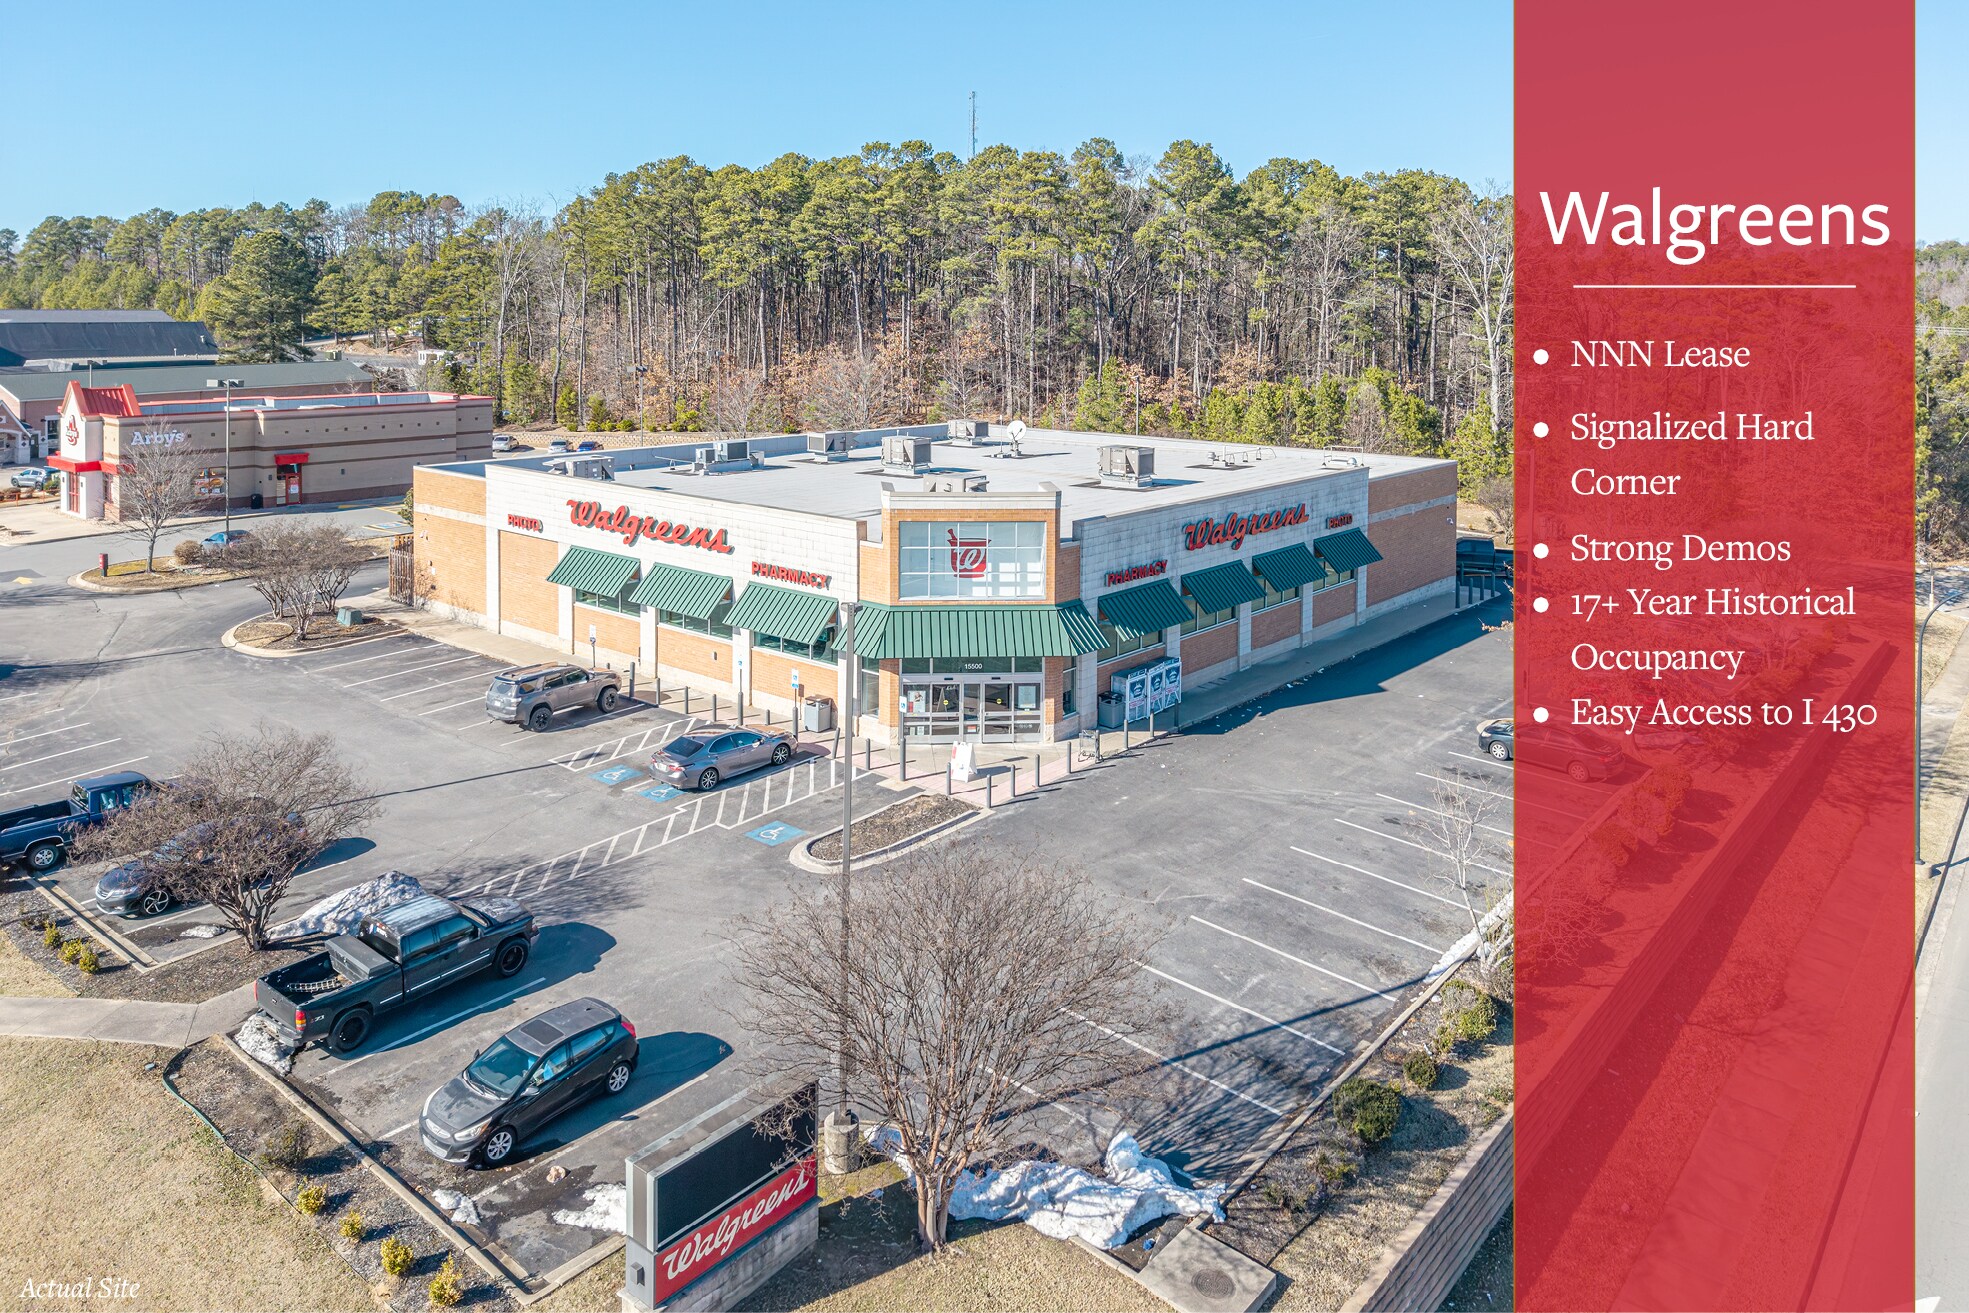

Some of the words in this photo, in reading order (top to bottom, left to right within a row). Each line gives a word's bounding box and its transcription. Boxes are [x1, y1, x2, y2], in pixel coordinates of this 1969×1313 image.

[508, 514, 540, 531] PHOTO
[566, 500, 732, 553] Walgreens
[1184, 503, 1309, 550] Walgreens
[751, 561, 829, 588] PHARMACY
[1107, 559, 1168, 587] PHARMACY
[663, 1168, 809, 1280] Walgreens
